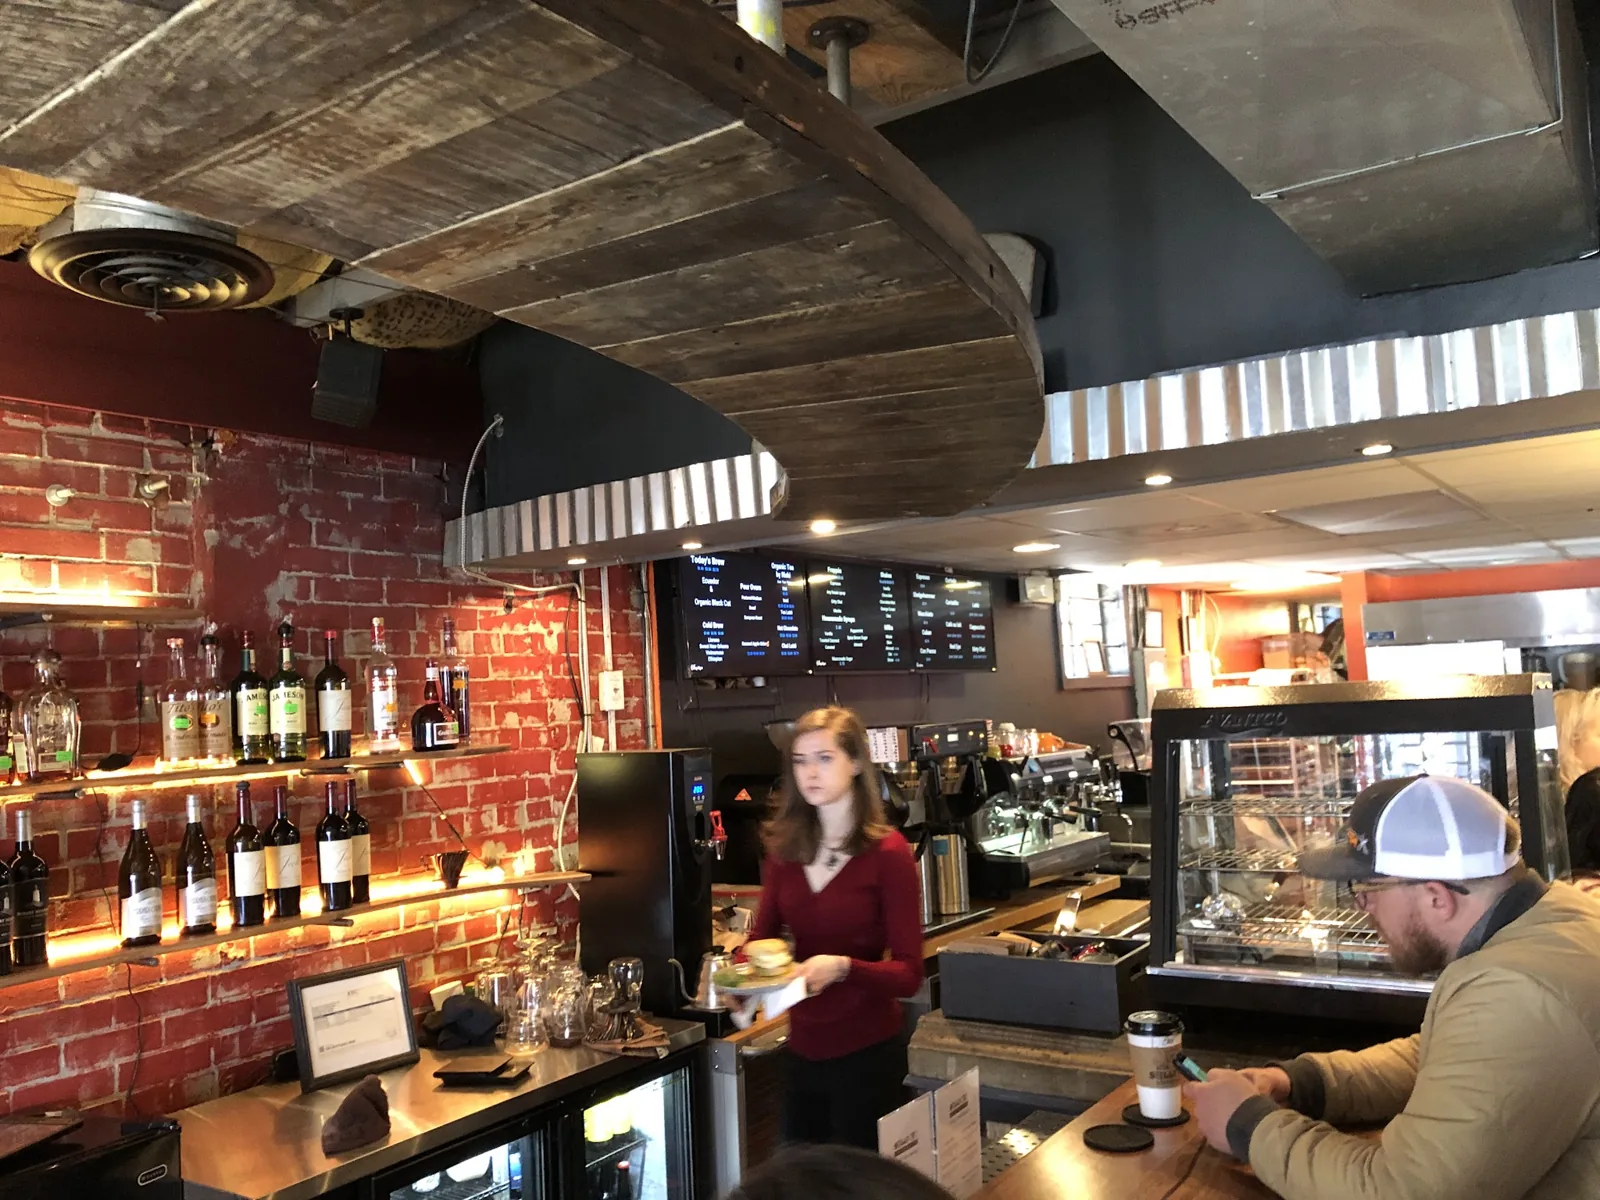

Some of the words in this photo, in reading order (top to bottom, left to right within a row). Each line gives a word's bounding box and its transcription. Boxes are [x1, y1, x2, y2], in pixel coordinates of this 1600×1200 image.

[690, 554, 711, 566] Today's
[712, 557, 725, 566] Brew
[694, 598, 711, 607] Organic
